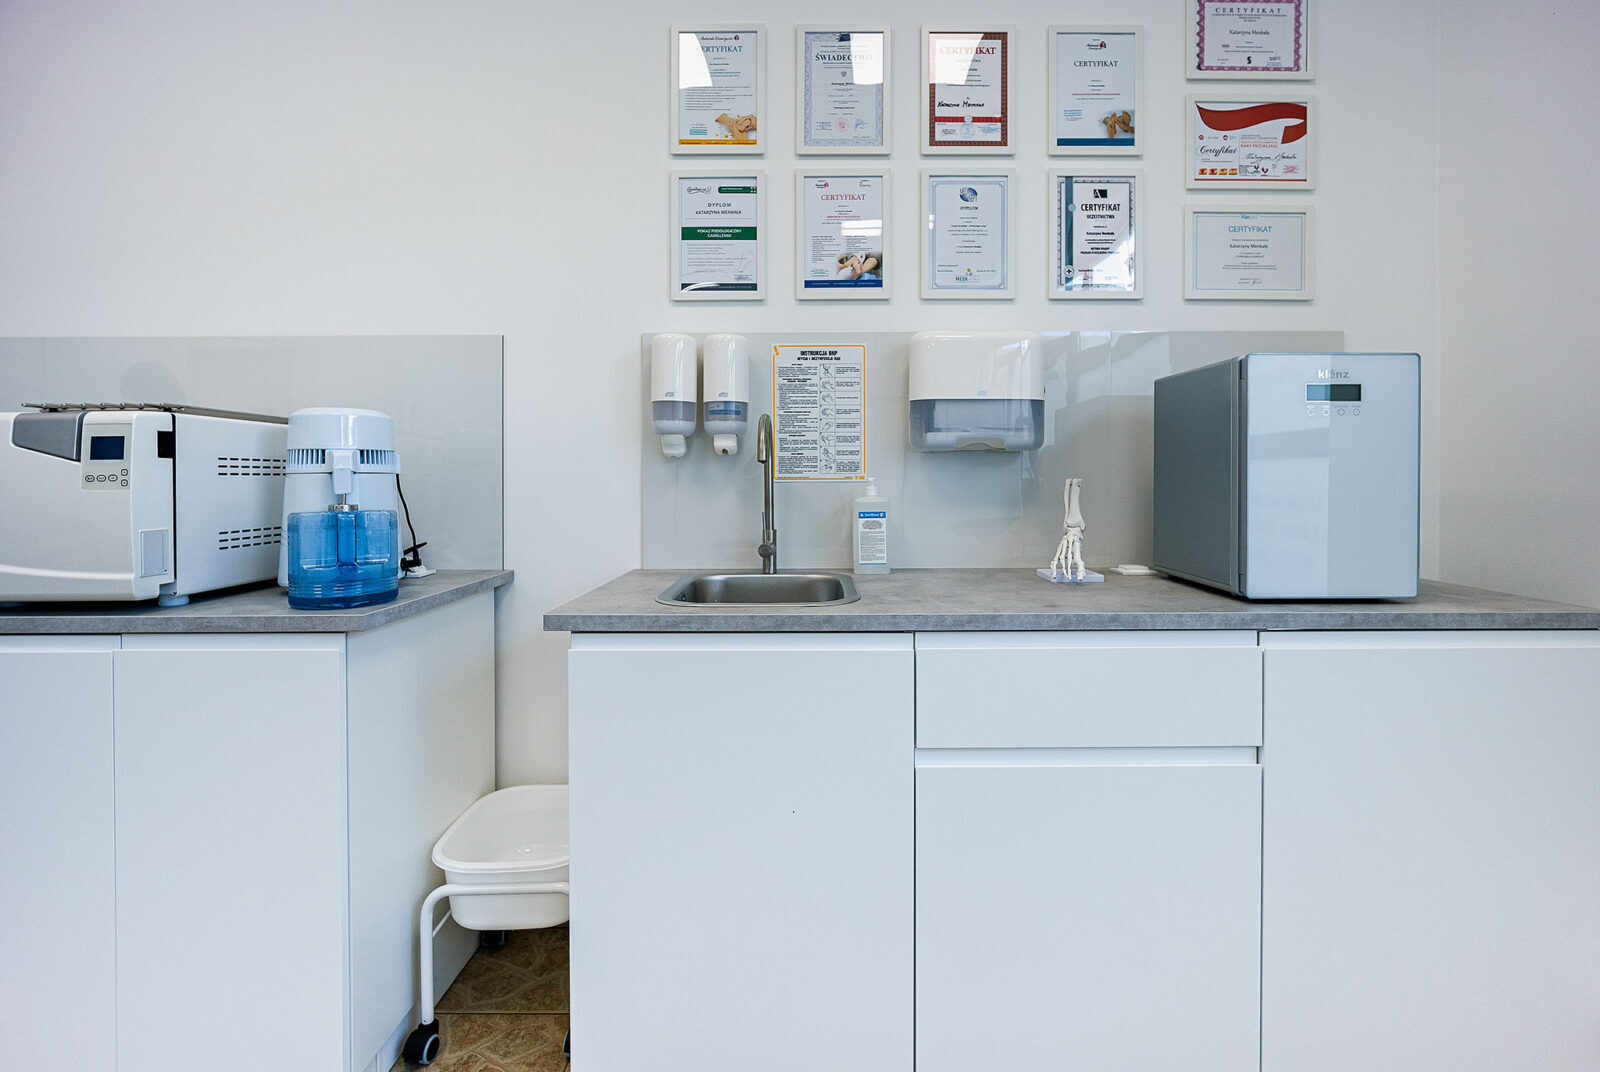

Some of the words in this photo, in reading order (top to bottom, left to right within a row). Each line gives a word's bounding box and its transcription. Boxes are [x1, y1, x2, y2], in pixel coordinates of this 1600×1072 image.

[820, 193, 866, 201] CERTYFIKAT
[1080, 203, 1121, 212] CERTYFIKAT
[1228, 225, 1272, 233] CERTYFIKAT
